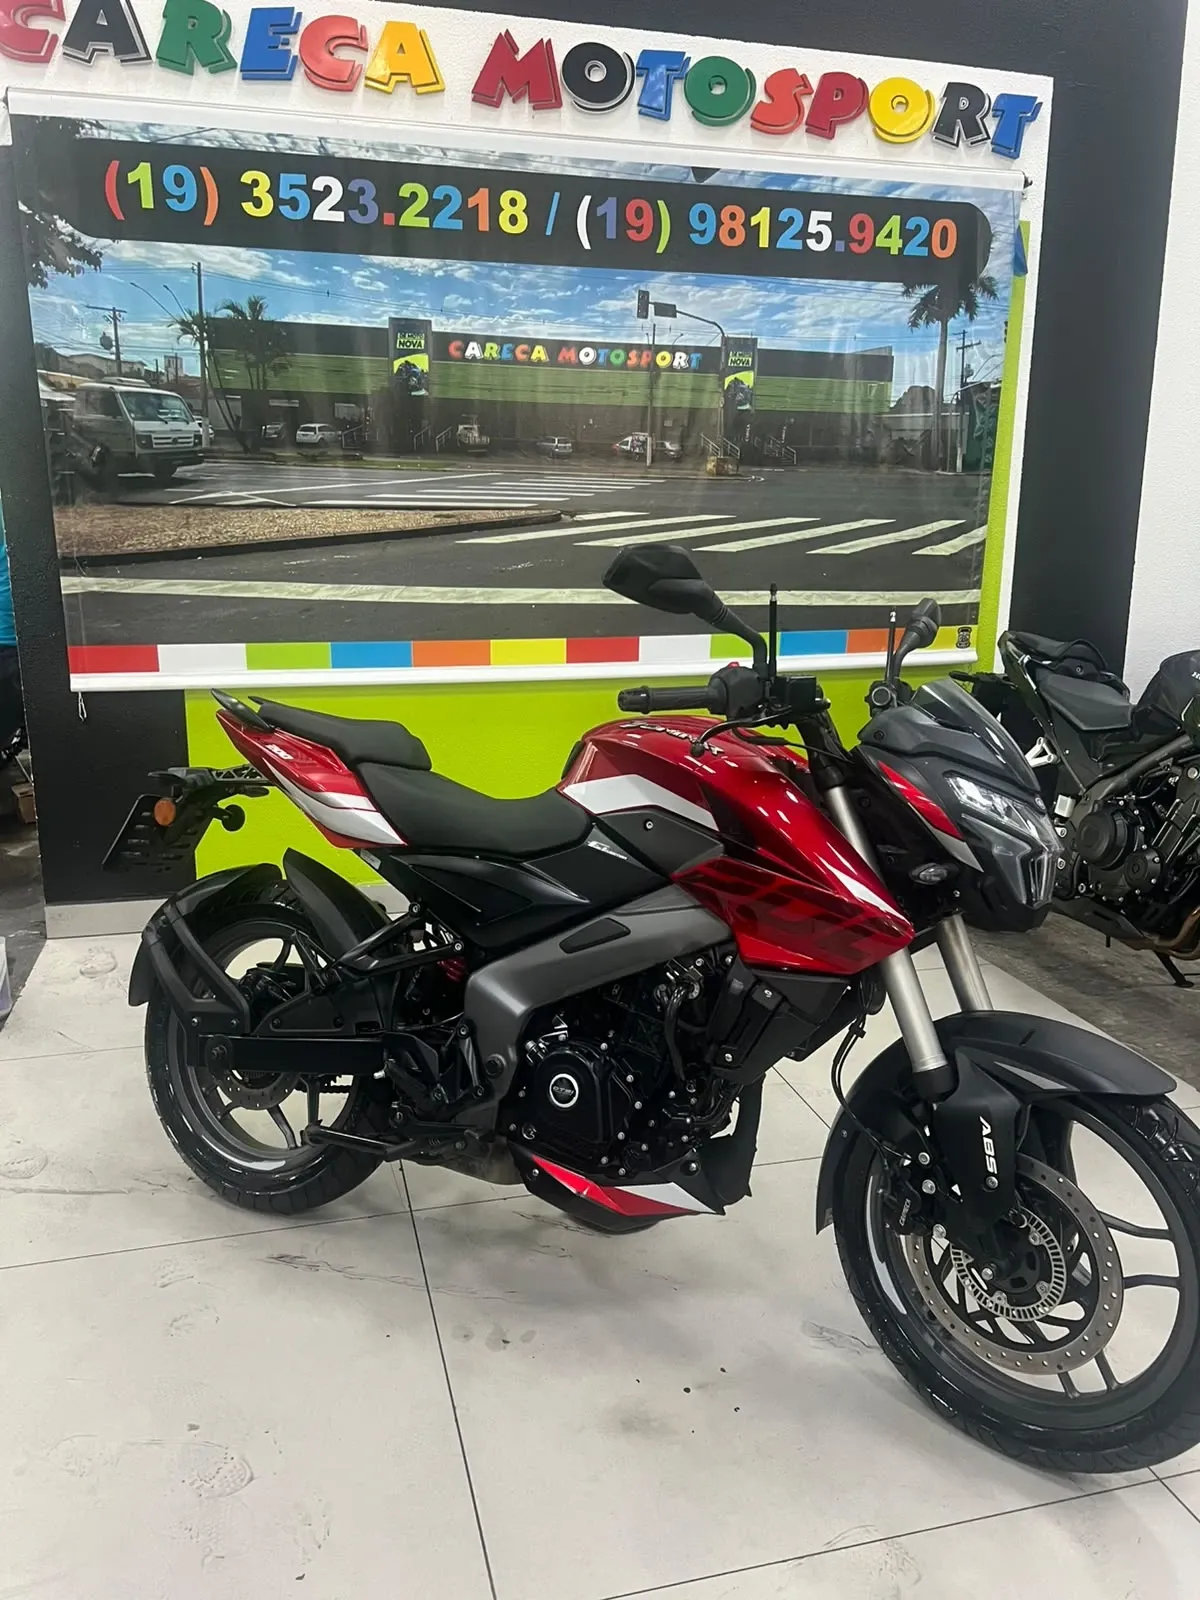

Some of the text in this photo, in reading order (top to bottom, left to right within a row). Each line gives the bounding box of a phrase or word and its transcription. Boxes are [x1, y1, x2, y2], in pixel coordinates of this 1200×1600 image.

[0, 0, 1043, 159] CARECA MOTOSPORT
[105, 160, 219, 226] (19)
[240, 170, 528, 234] 3523.2218
[576, 195, 670, 253] (19)
[689, 203, 957, 259] 98125.9420
[399, 340, 423, 348] NOVA
[448, 340, 702, 370] CARECA MOTOSPORT
[730, 357, 750, 366] NOVA
[980, 1116, 998, 1174] ABS
